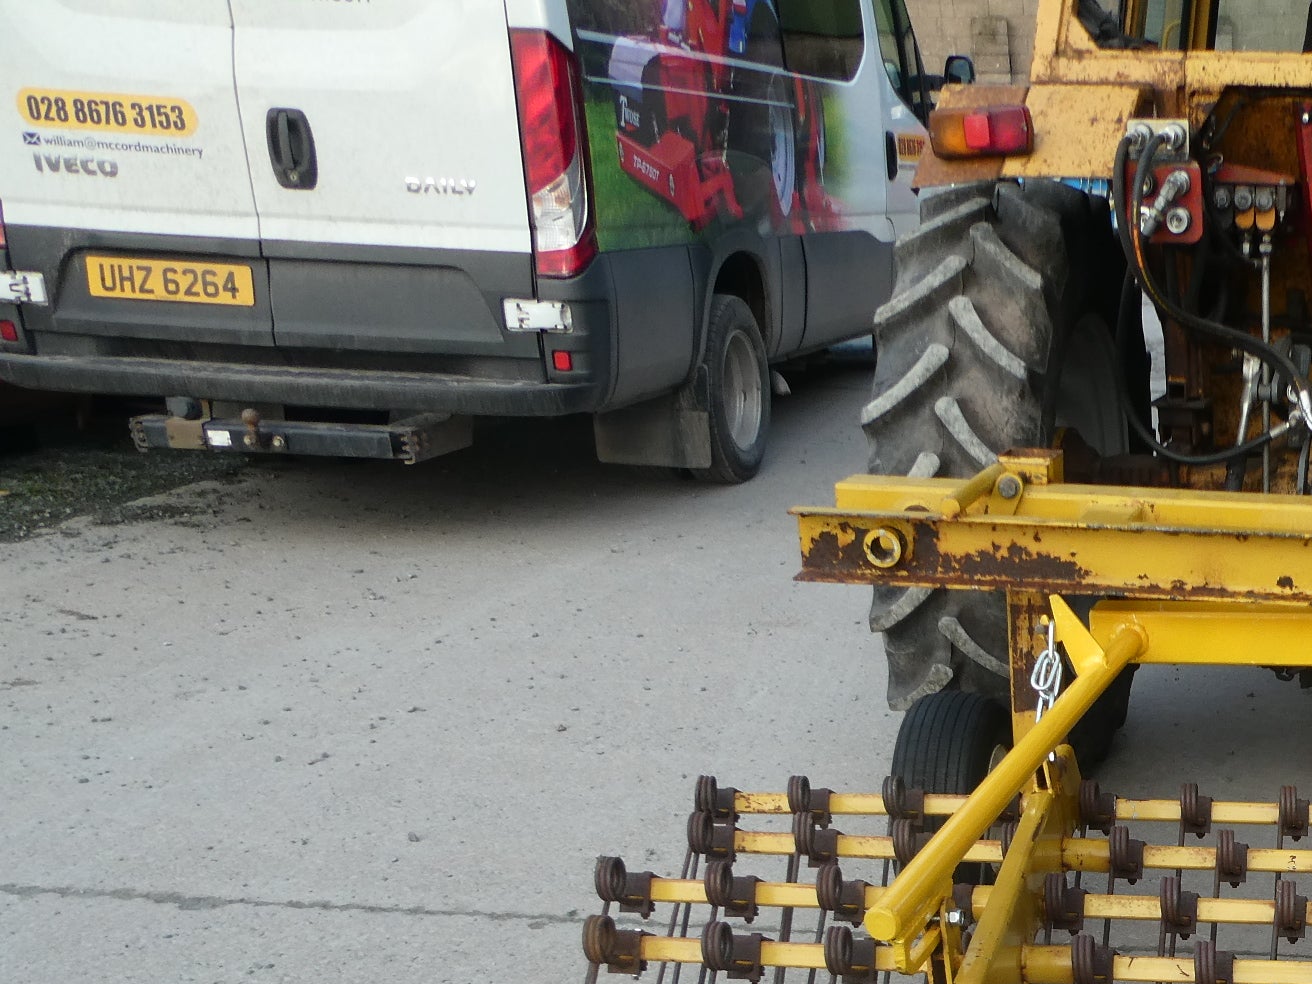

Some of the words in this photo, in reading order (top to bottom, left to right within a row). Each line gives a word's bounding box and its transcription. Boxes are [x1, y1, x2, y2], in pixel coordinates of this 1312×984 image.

[26, 94, 69, 122] 028
[72, 98, 127, 127] 8676
[130, 102, 186, 131] 3153
[43, 136, 204, 159] william@mccordmachinery
[32, 151, 119, 177] IVECO
[404, 176, 477, 195] DAILY
[99, 263, 155, 295] UHZ
[161, 267, 240, 300] 6264
